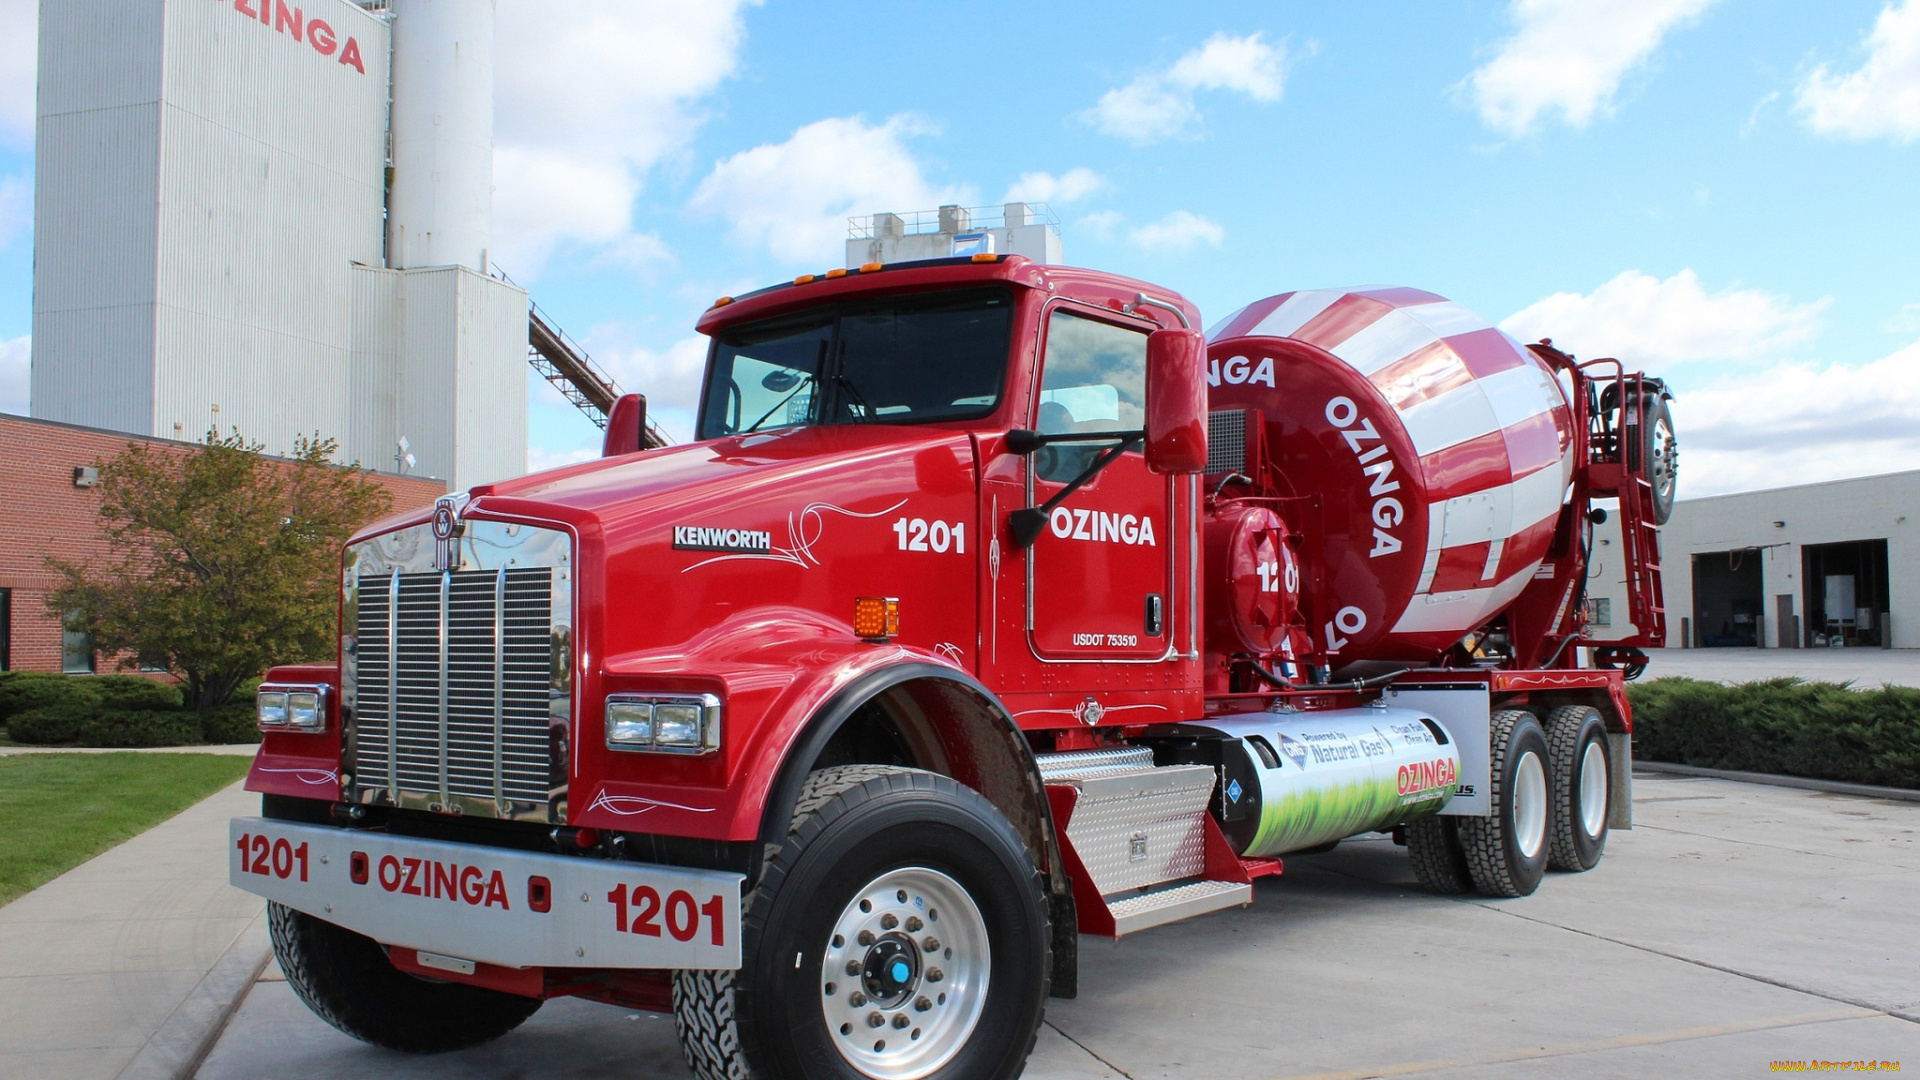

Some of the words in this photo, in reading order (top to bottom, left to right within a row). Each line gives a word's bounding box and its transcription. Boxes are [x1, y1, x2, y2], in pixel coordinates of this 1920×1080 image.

[215, 0, 365, 75] INGA
[1207, 355, 1275, 388] NGA
[1325, 396, 1404, 558] OZINGA
[674, 526, 770, 549] KENWORTH
[893, 517, 965, 554] 1201
[1050, 507, 1156, 547] OZINGA
[1073, 633, 1105, 646] USDOT
[1107, 634, 1137, 647] 753510
[1301, 732, 1337, 743] Powered
[1336, 730, 1347, 741] by
[1311, 744, 1360, 764] Natural
[1359, 739, 1385, 758] Gas
[1396, 757, 1457, 796] OZINGA
[237, 834, 309, 882] 1201
[378, 853, 510, 910] OZINGA
[607, 883, 724, 946] 1201
